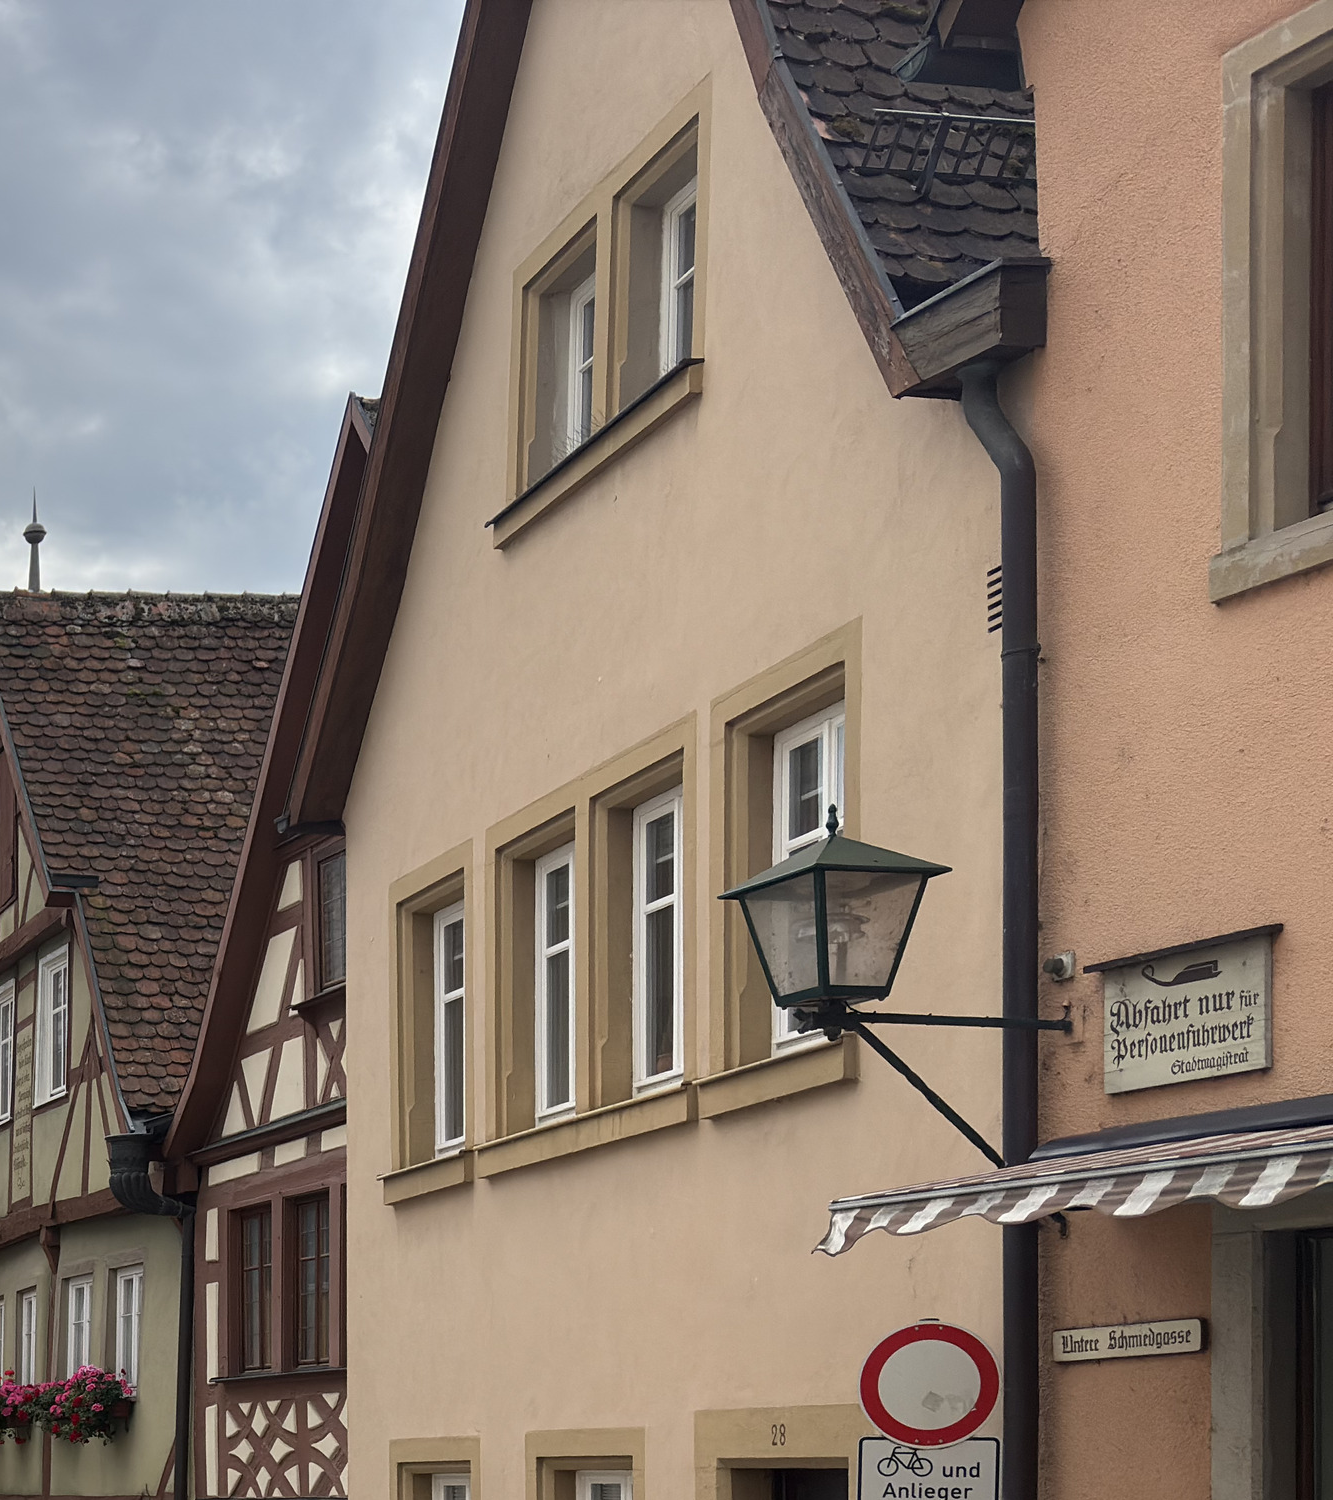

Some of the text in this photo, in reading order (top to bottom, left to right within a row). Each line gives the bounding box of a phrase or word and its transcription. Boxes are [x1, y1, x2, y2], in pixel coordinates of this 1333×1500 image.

[1110, 989, 1259, 1037] Abfahrt nur für
[1171, 1046, 1249, 1075] Stadtmagistrat
[1062, 1328, 1191, 1354] Untere Schmiedgasse
[771, 1423, 786, 1446] 28
[942, 1462, 980, 1478] und
